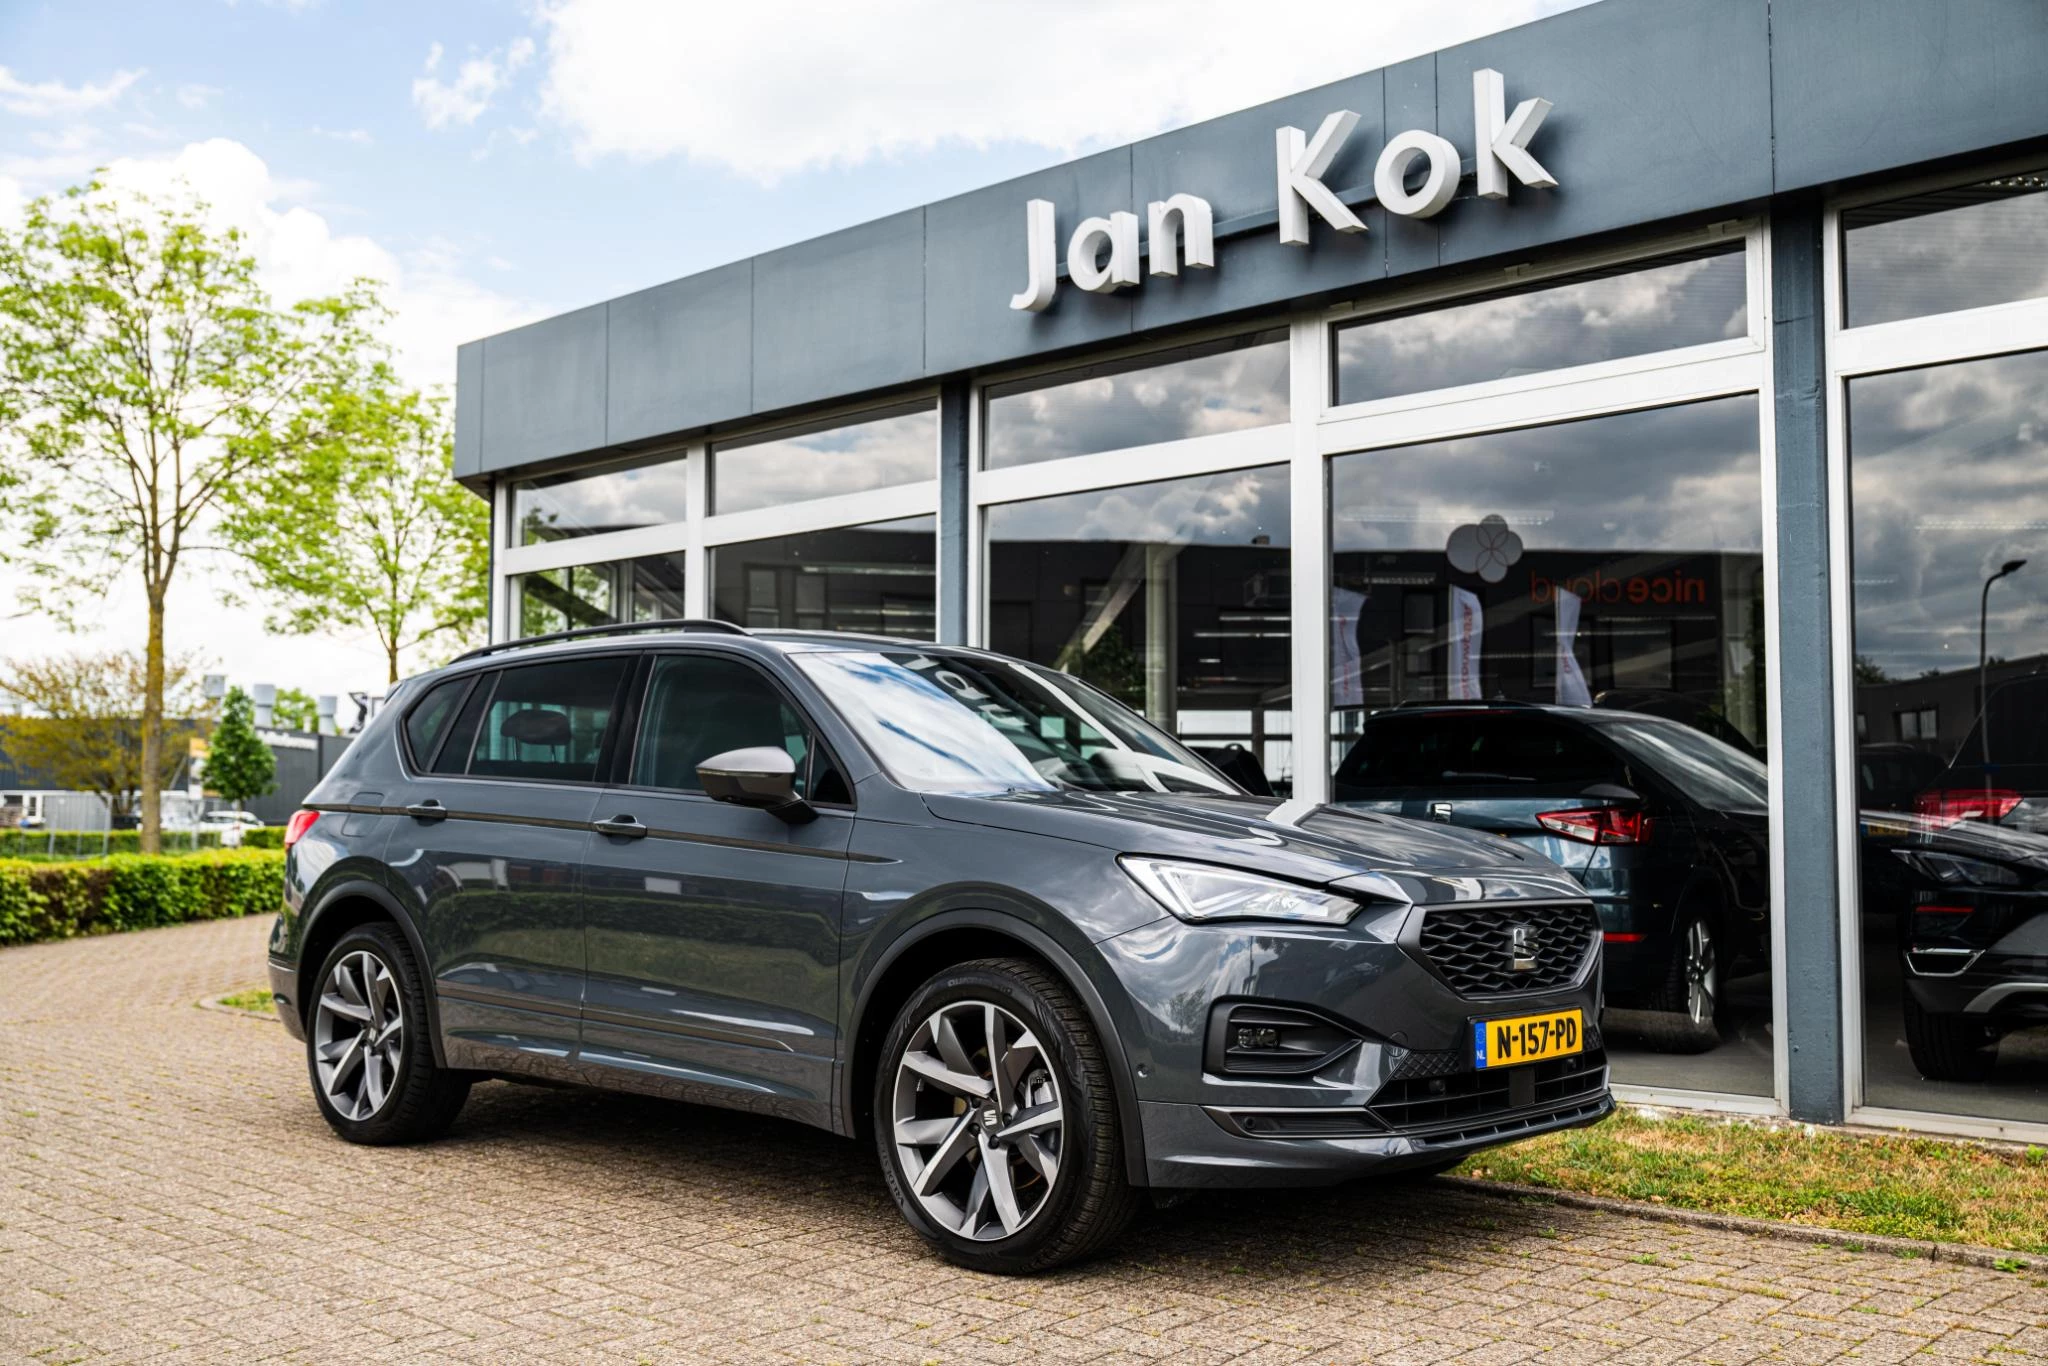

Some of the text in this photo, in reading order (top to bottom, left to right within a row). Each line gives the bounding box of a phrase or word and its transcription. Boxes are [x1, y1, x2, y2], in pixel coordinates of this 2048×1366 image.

[1010, 67, 1559, 312] Jan Kok
[1477, 1050, 1486, 1060] NL
[1497, 1016, 1577, 1059] N-157-PD
